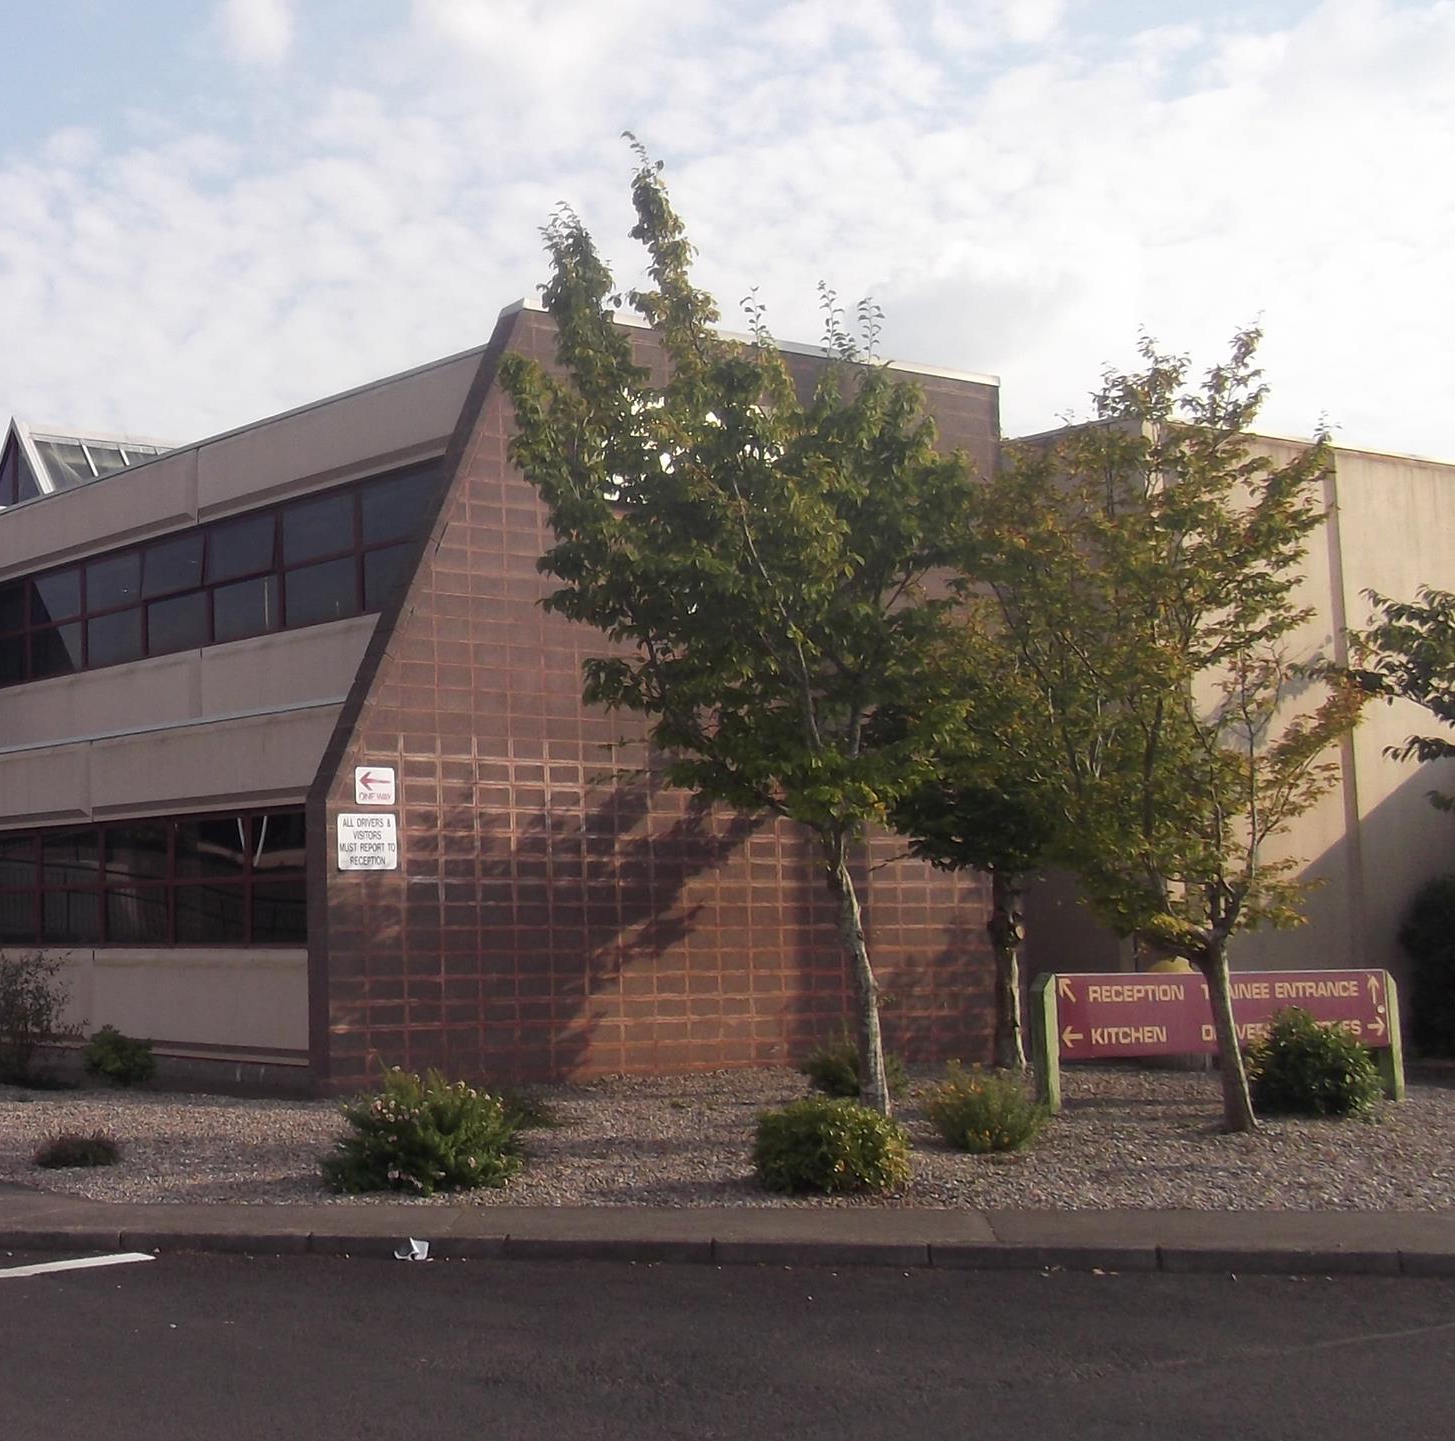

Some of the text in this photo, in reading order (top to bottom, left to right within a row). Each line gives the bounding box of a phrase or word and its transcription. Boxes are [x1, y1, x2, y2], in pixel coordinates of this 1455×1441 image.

[359, 792, 391, 800] ONE WAY
[343, 818, 354, 827] ALL
[357, 818, 384, 827] DRIVERS
[353, 830, 382, 840] VISITORS
[339, 843, 396, 852] MUST REPORT TO
[350, 856, 386, 865] RECEPTION
[1088, 984, 1185, 1002] RECEPTION
[1274, 981, 1359, 998] ENTRANCE
[1091, 1026, 1167, 1045] KITCHEN
